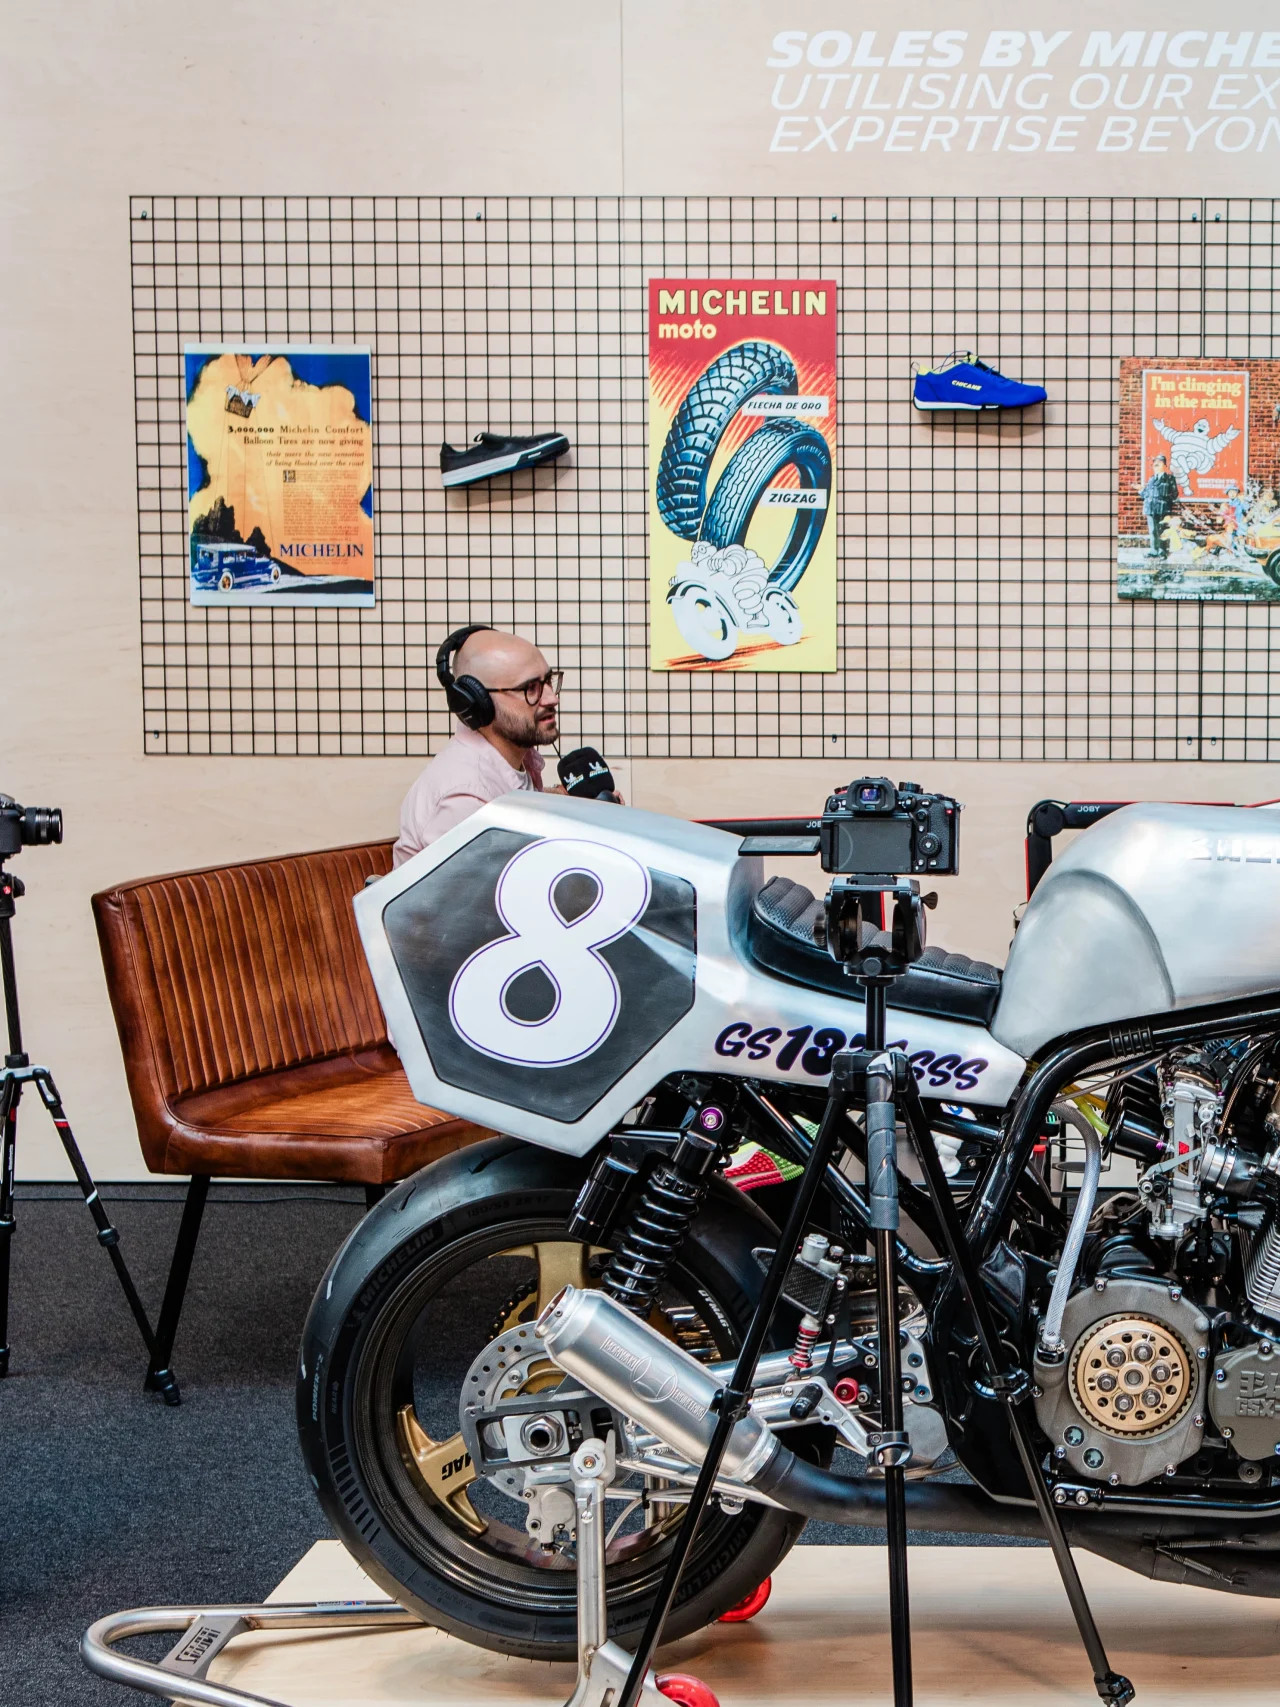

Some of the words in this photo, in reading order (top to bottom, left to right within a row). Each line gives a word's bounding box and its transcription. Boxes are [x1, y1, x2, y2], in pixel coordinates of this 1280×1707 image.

[766, 31, 962, 68] SOLES
[978, 31, 1071, 67] BY
[769, 74, 1054, 111] UTILISING
[1070, 74, 1194, 111] OUR
[768, 115, 1083, 153] EXPERTISE
[657, 289, 827, 316] MICHELIN
[658, 318, 717, 339] moto
[951, 380, 982, 391] CHICANE
[1151, 376, 1176, 391] I'm
[1178, 377, 1242, 397] clinging
[747, 401, 782, 410] FLECHA
[786, 402, 797, 410] DE
[800, 402, 822, 410] ORO
[1154, 393, 1171, 408] in
[1173, 393, 1199, 408] the
[1200, 395, 1237, 409] rain.
[280, 425, 320, 434] Michelin
[325, 425, 364, 434] Comfort
[244, 436, 274, 445] Balloon
[278, 436, 298, 445] Tires
[339, 437, 364, 447] giving
[768, 493, 817, 504] ZIGZAG
[279, 543, 364, 557] MICHELIN
[1077, 805, 1100, 813] JOBY
[449, 836, 653, 1068] 8
[361, 1228, 436, 1306] MICHELIN
[698, 1289, 729, 1328] DYMAG
[311, 1372, 320, 1422] POWER
